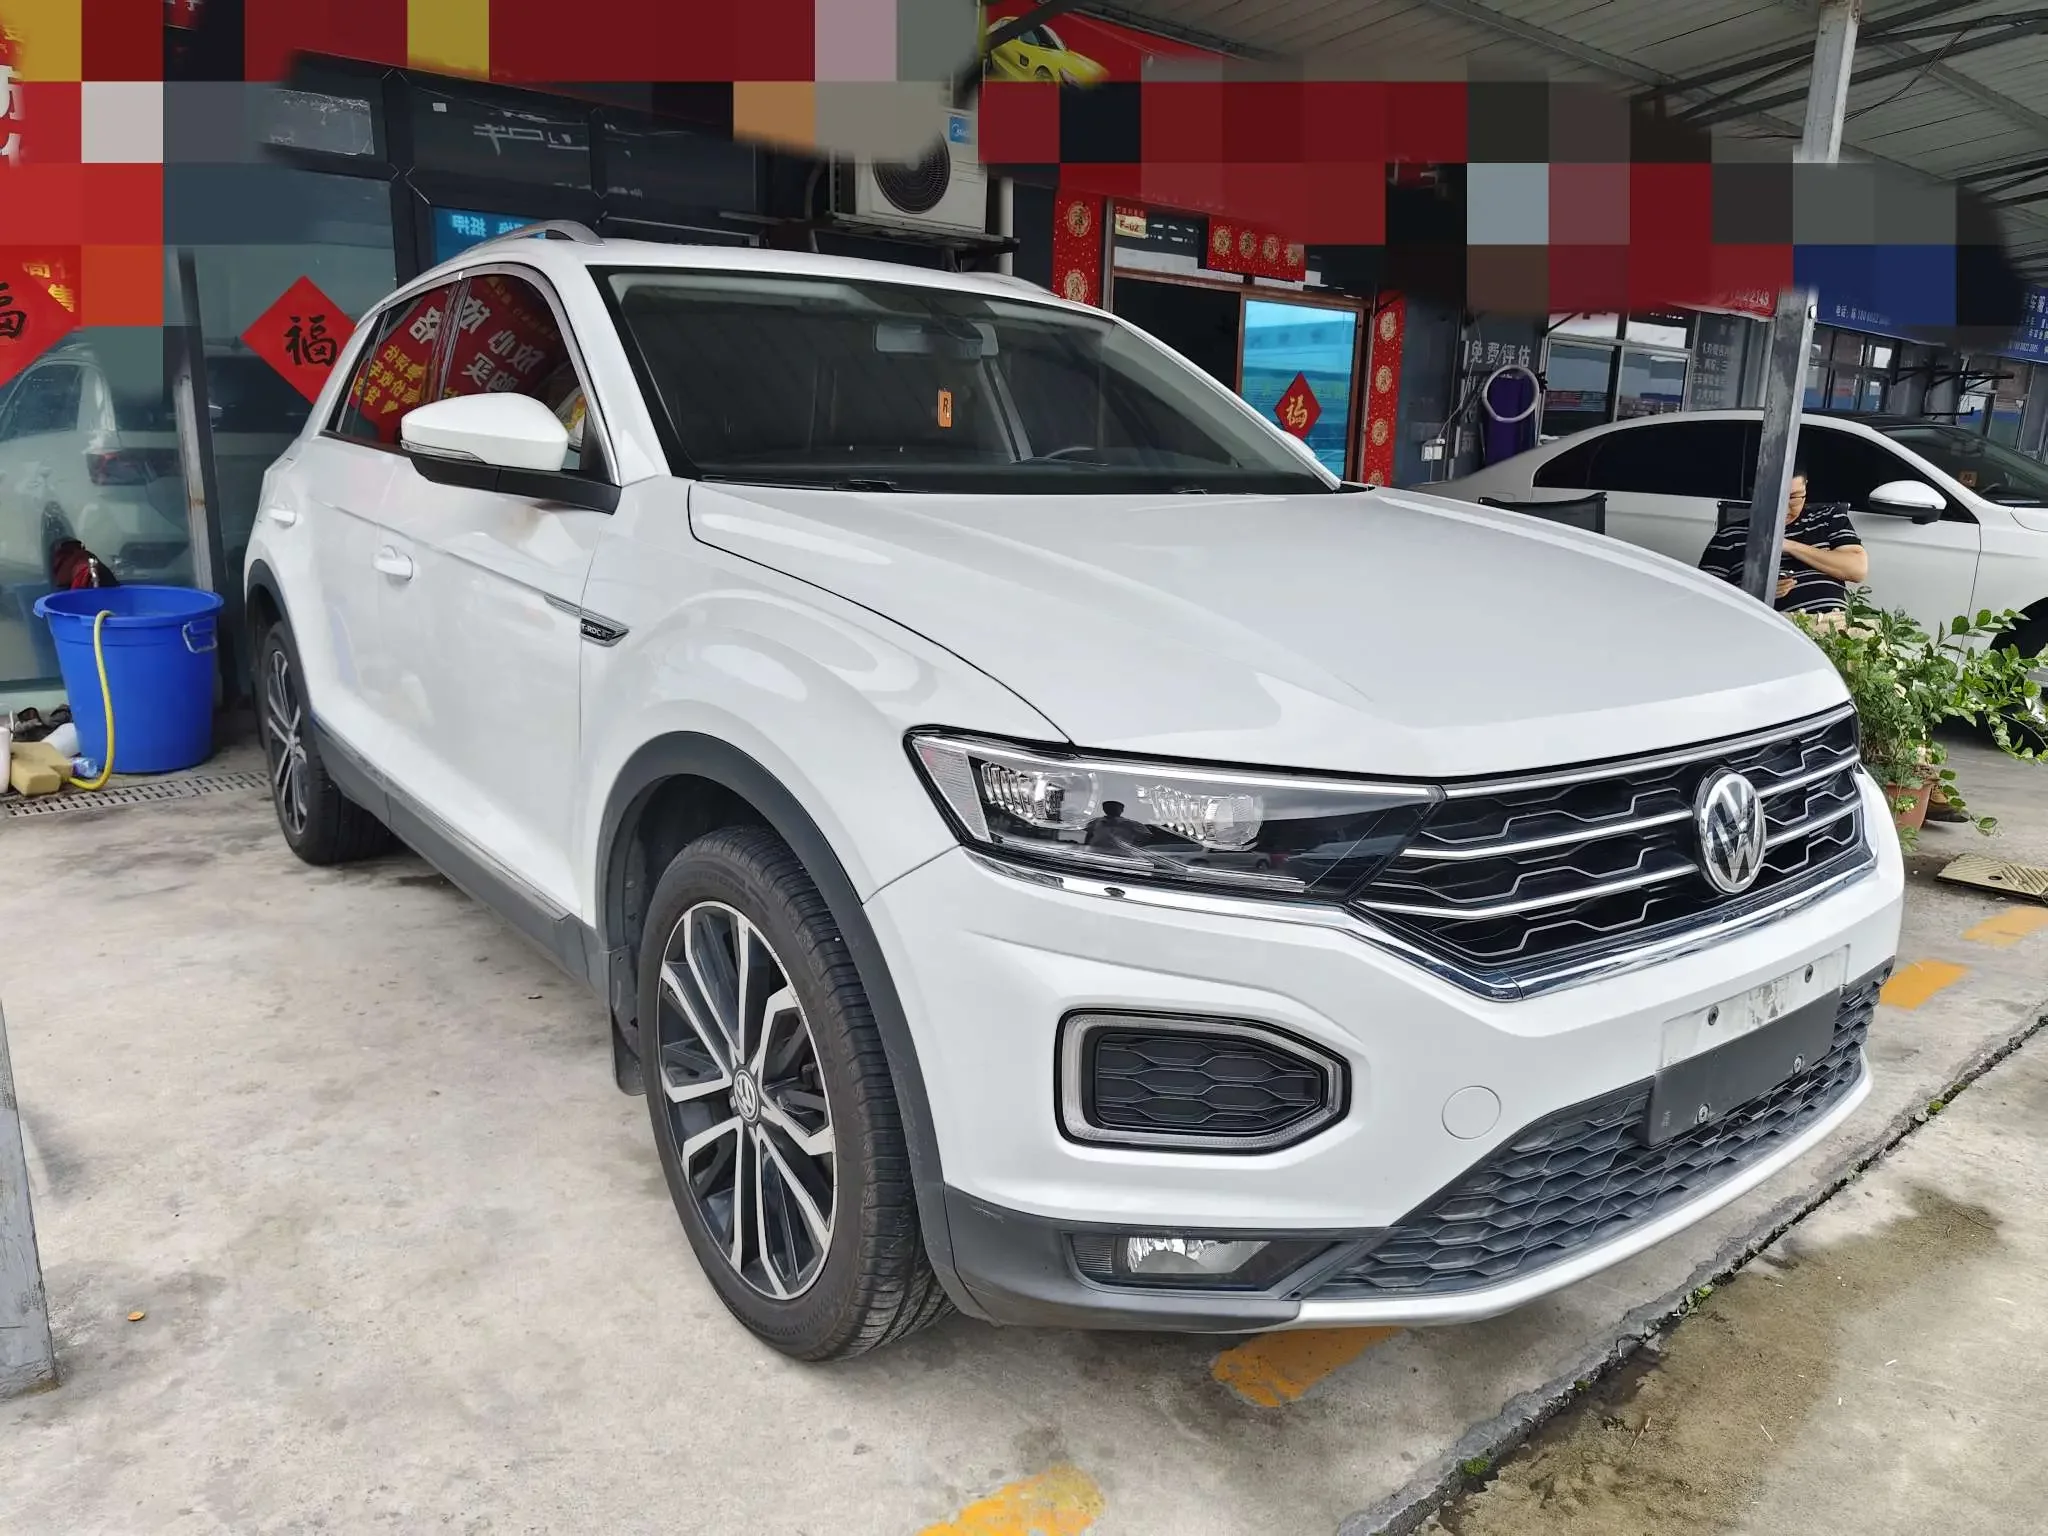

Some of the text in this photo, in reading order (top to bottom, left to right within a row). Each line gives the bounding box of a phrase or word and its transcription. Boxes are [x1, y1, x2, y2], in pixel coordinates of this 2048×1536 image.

[284, 314, 338, 367] 福
[1470, 339, 1531, 368] 免费评估
[1286, 395, 1308, 429] 福
